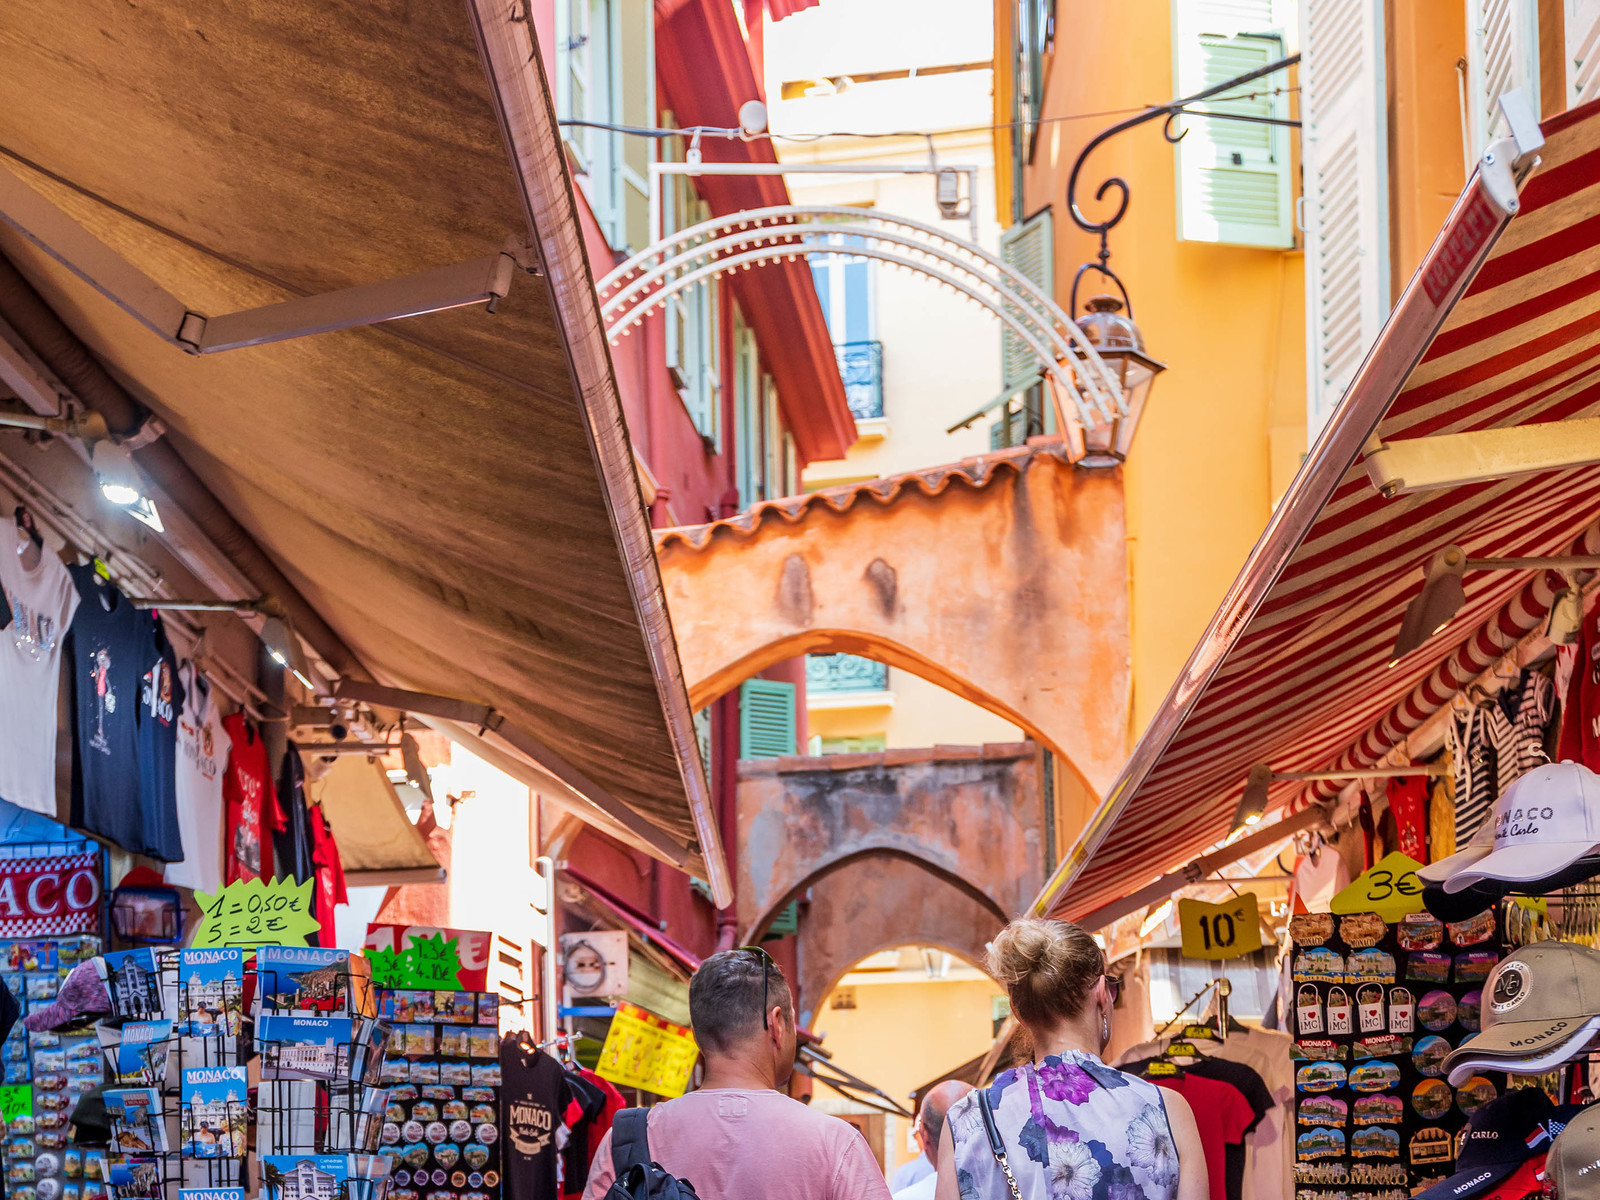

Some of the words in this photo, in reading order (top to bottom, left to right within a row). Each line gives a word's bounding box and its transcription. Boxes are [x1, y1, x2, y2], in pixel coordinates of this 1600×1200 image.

[1510, 822, 1539, 836] Carlo
[1367, 870, 1425, 901] 3€
[208, 923, 222, 944] 5
[1299, 938, 1323, 946] MONACO
[1351, 938, 1376, 946] MONACO
[184, 950, 238, 961] MONACO
[267, 948, 348, 963] MONACO
[293, 1019, 329, 1028] MONACO
[1303, 1020, 1318, 1030] MC
[1333, 1021, 1347, 1030] MC
[1365, 1018, 1379, 1028] MC
[1395, 1020, 1408, 1029] MC
[123, 1028, 154, 1042] MONACO
[1365, 1034, 1396, 1045] MONACO
[1510, 1021, 1568, 1048] MONACO
[186, 1070, 241, 1081] MONACO
[509, 1105, 552, 1131] MONACO
[1471, 1131, 1499, 1139] CARLO
[1294, 1172, 1349, 1185] MONACO
[1351, 1173, 1408, 1186] MONACO
[1453, 1171, 1492, 1195] MONACO
